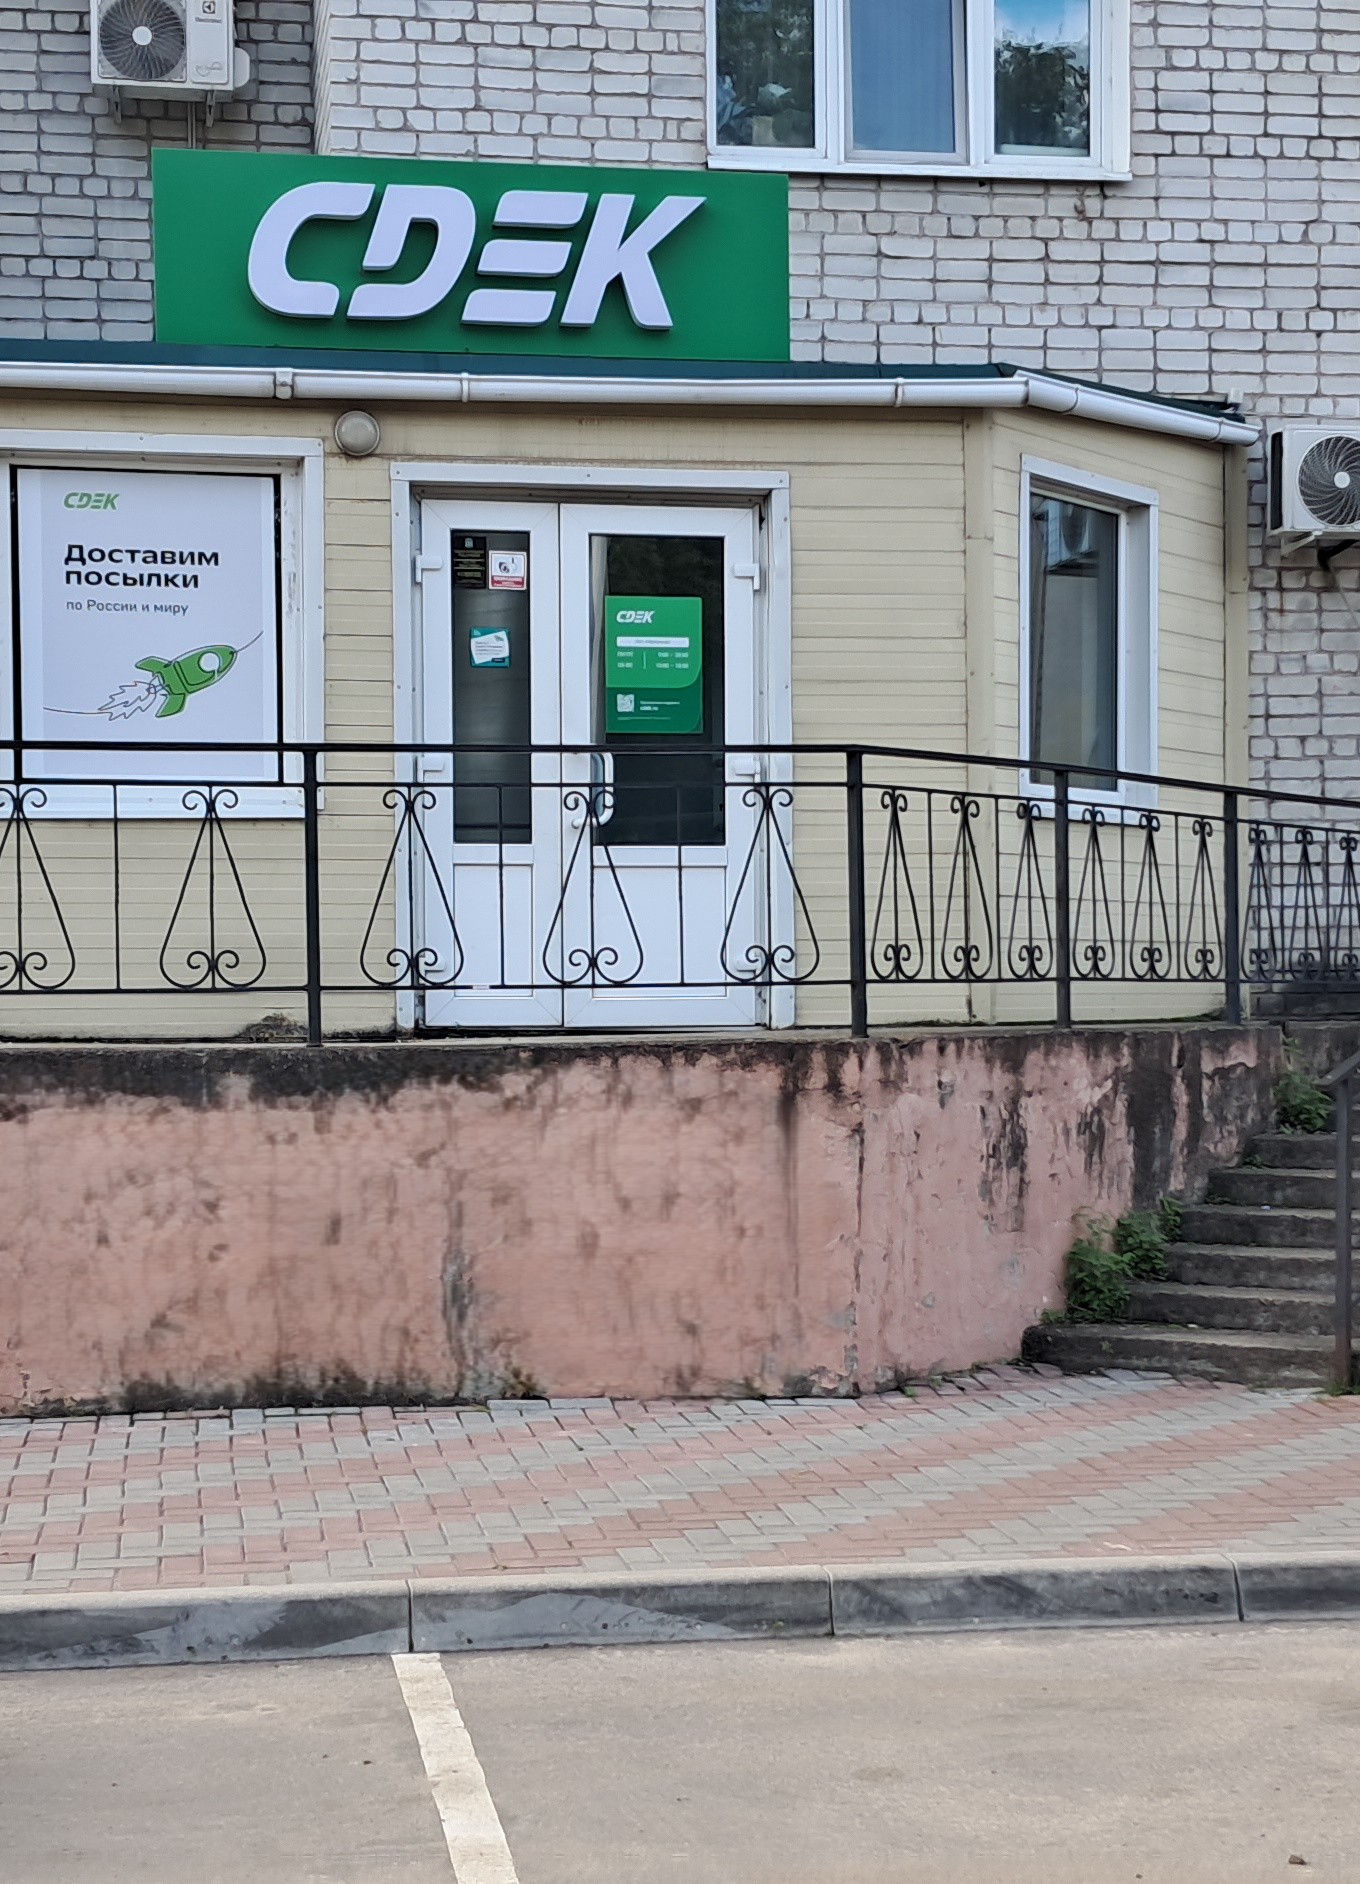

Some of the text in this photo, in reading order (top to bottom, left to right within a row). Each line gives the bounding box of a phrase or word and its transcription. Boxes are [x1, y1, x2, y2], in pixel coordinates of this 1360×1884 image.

[247, 181, 707, 330] CDEK
[64, 491, 120, 511] CDEK
[64, 544, 220, 567] Доставим
[65, 570, 199, 589] посылки
[66, 599, 189, 616] по России и миру
[616, 610, 656, 624] CDEK
